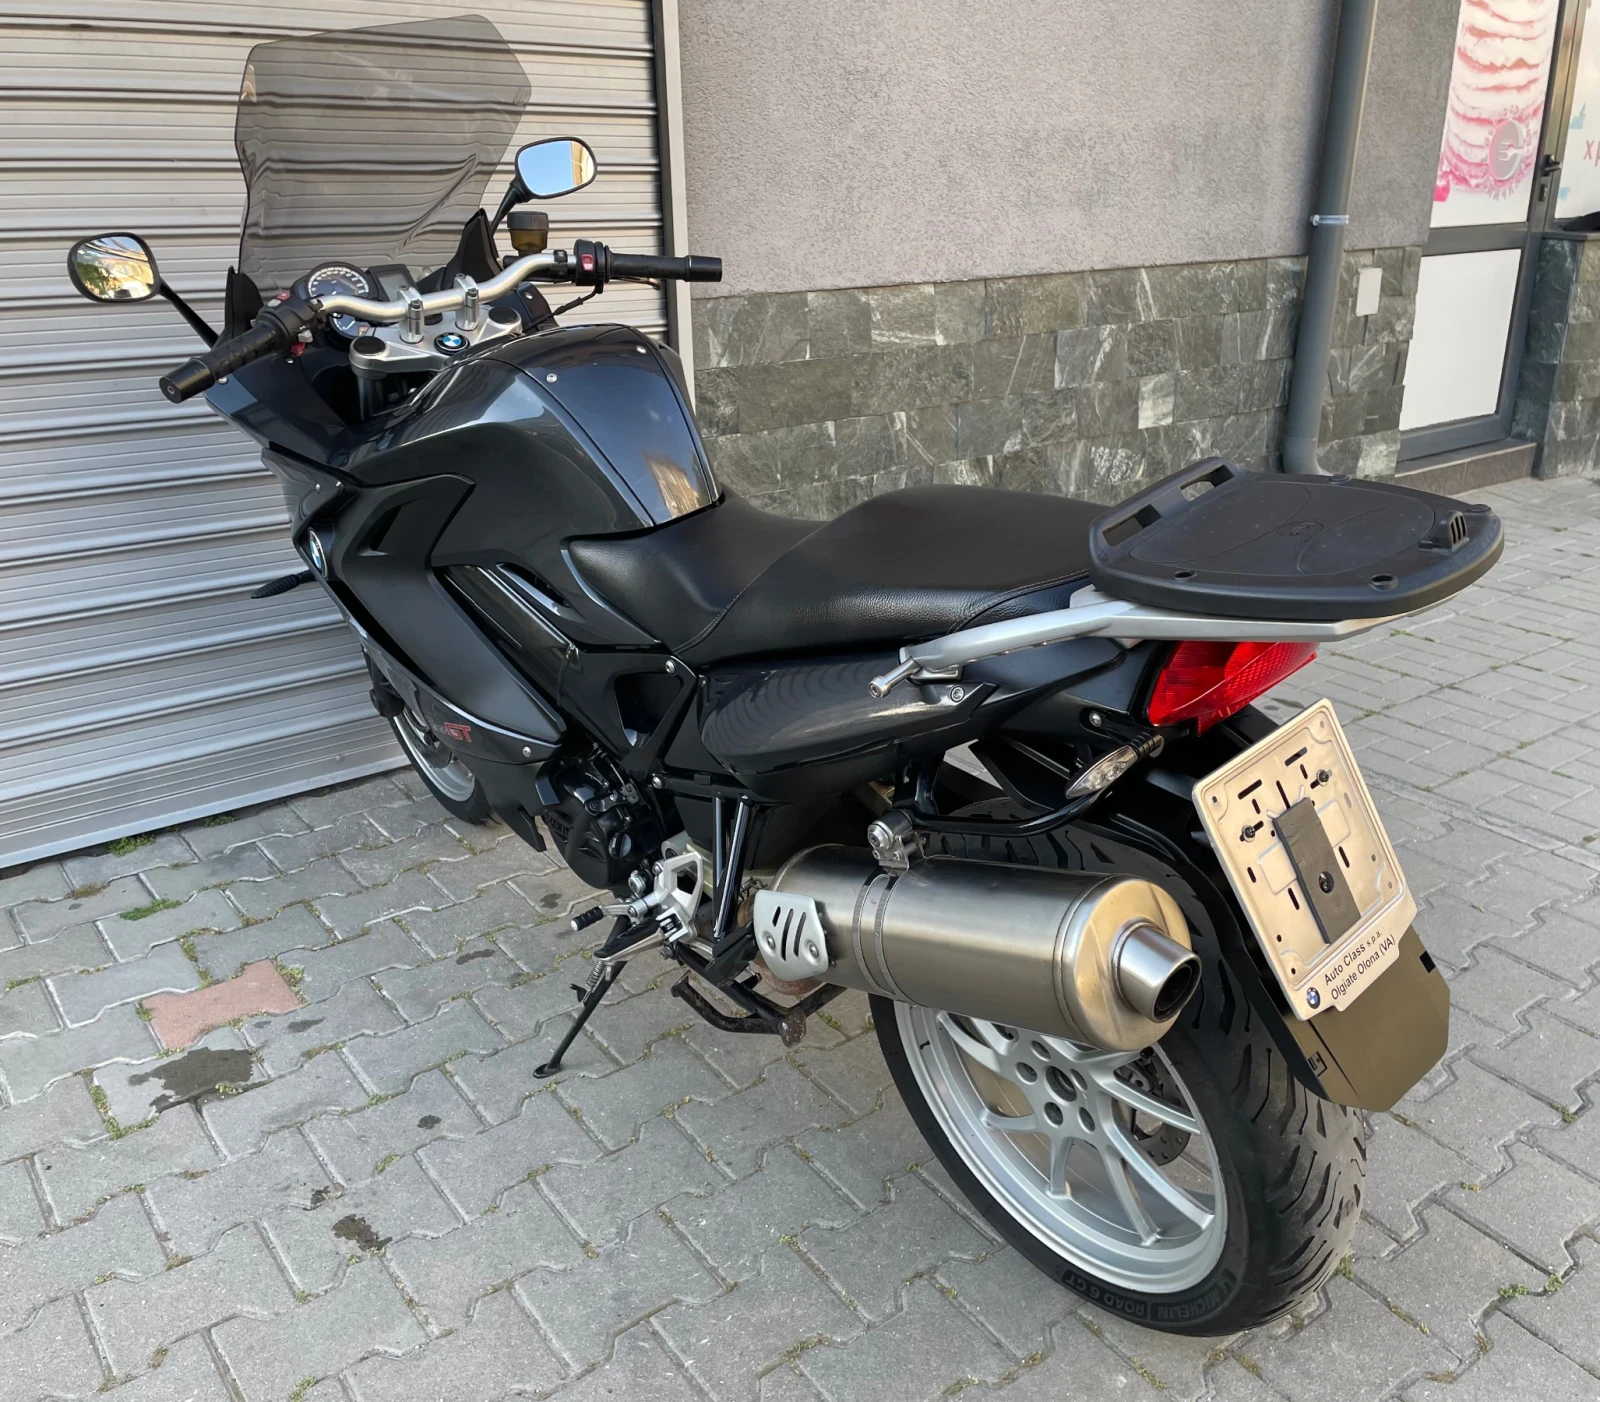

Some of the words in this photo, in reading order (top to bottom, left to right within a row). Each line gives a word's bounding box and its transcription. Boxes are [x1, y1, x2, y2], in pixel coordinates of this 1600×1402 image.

[443, 721, 472, 743] GT
[1324, 964, 1343, 986] Auto
[1344, 943, 1366, 966] Class
[1331, 971, 1357, 1000] Olgiate
[1357, 952, 1380, 975] Olona
[1380, 934, 1396, 956] (VA)
[1089, 1286, 1100, 1299] 6
[1103, 1295, 1145, 1316] ROAD
[1157, 1289, 1221, 1319] MICHELIN
